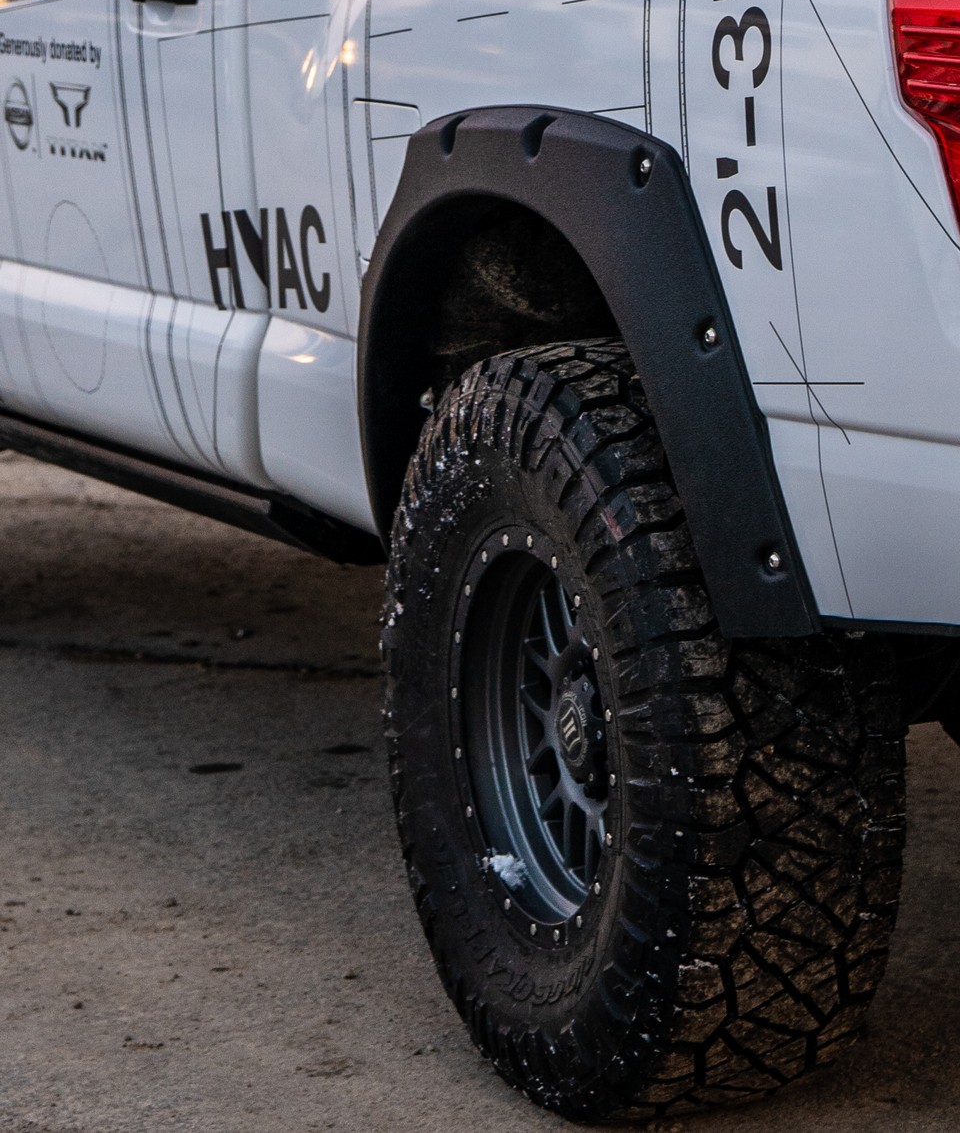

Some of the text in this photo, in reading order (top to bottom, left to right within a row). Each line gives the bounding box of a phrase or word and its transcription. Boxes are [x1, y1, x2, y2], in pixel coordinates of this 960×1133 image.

[50, 37, 87, 62] donated
[89, 42, 101, 69] by
[200, 204, 330, 313] HVAC
